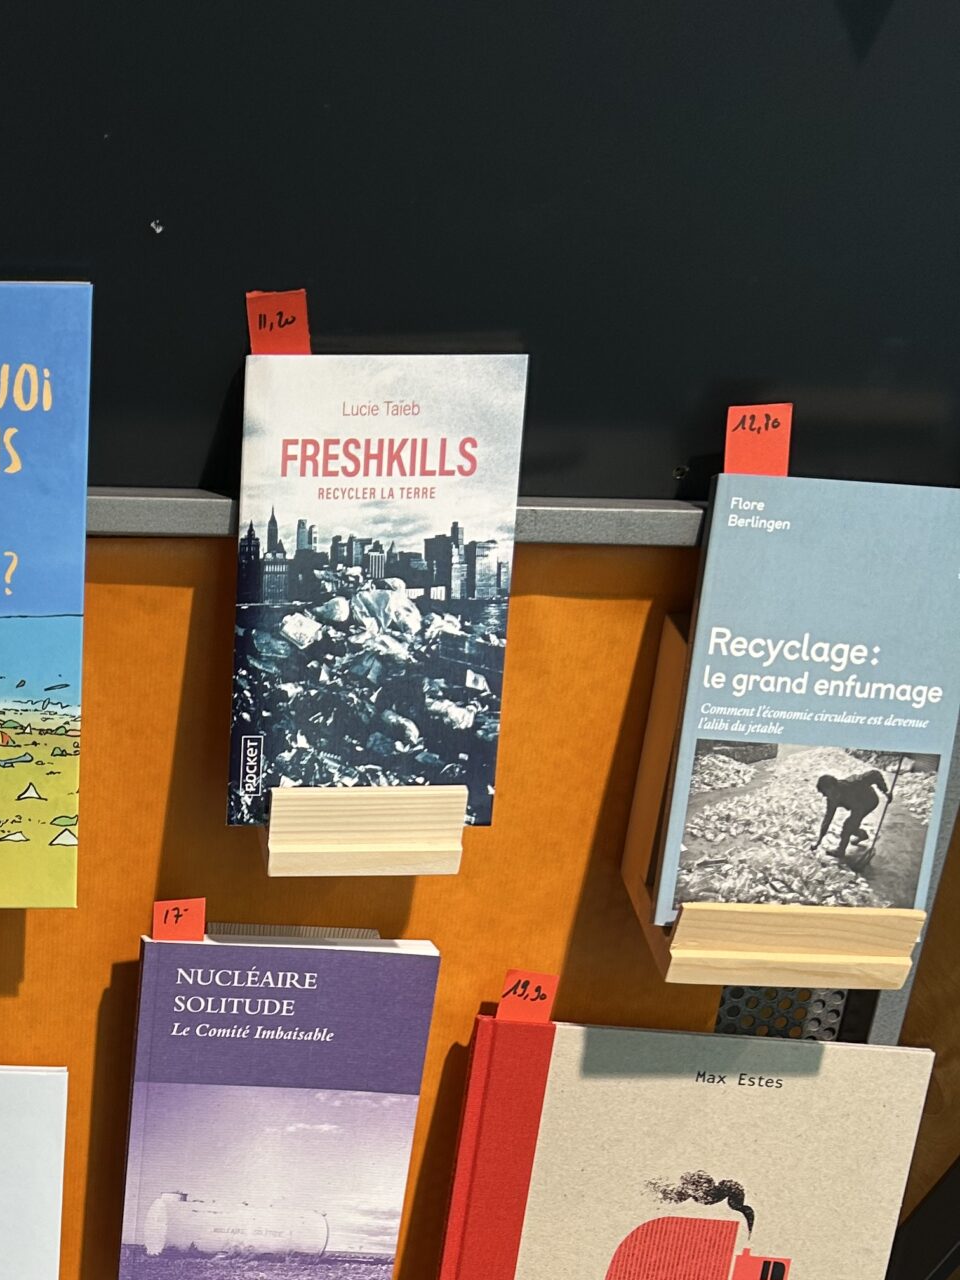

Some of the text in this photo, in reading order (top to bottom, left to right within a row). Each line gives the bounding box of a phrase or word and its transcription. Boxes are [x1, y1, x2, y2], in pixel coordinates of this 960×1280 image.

[342, 400, 421, 417] Lucie Taïeb
[280, 437, 478, 478] FRESHKILLS
[317, 486, 436, 501] RECYCLER LA TERRE
[730, 497, 765, 511] Flore
[727, 514, 791, 532] Berlingen
[703, 665, 943, 709] le grand enfumage
[700, 702, 755, 718] Comment
[814, 709, 866, 725] circulaire
[867, 714, 883, 726] est
[883, 714, 930, 729] devenue
[731, 719, 745, 733] du
[744, 720, 784, 735] jetable
[244, 739, 260, 792] POCKET
[176, 966, 318, 990] NUCLÉAIRE
[173, 995, 295, 1016] SOLITUDE
[171, 1022, 334, 1043] Le Comité Imbaisable
[695, 1070, 783, 1089] Max Estes
